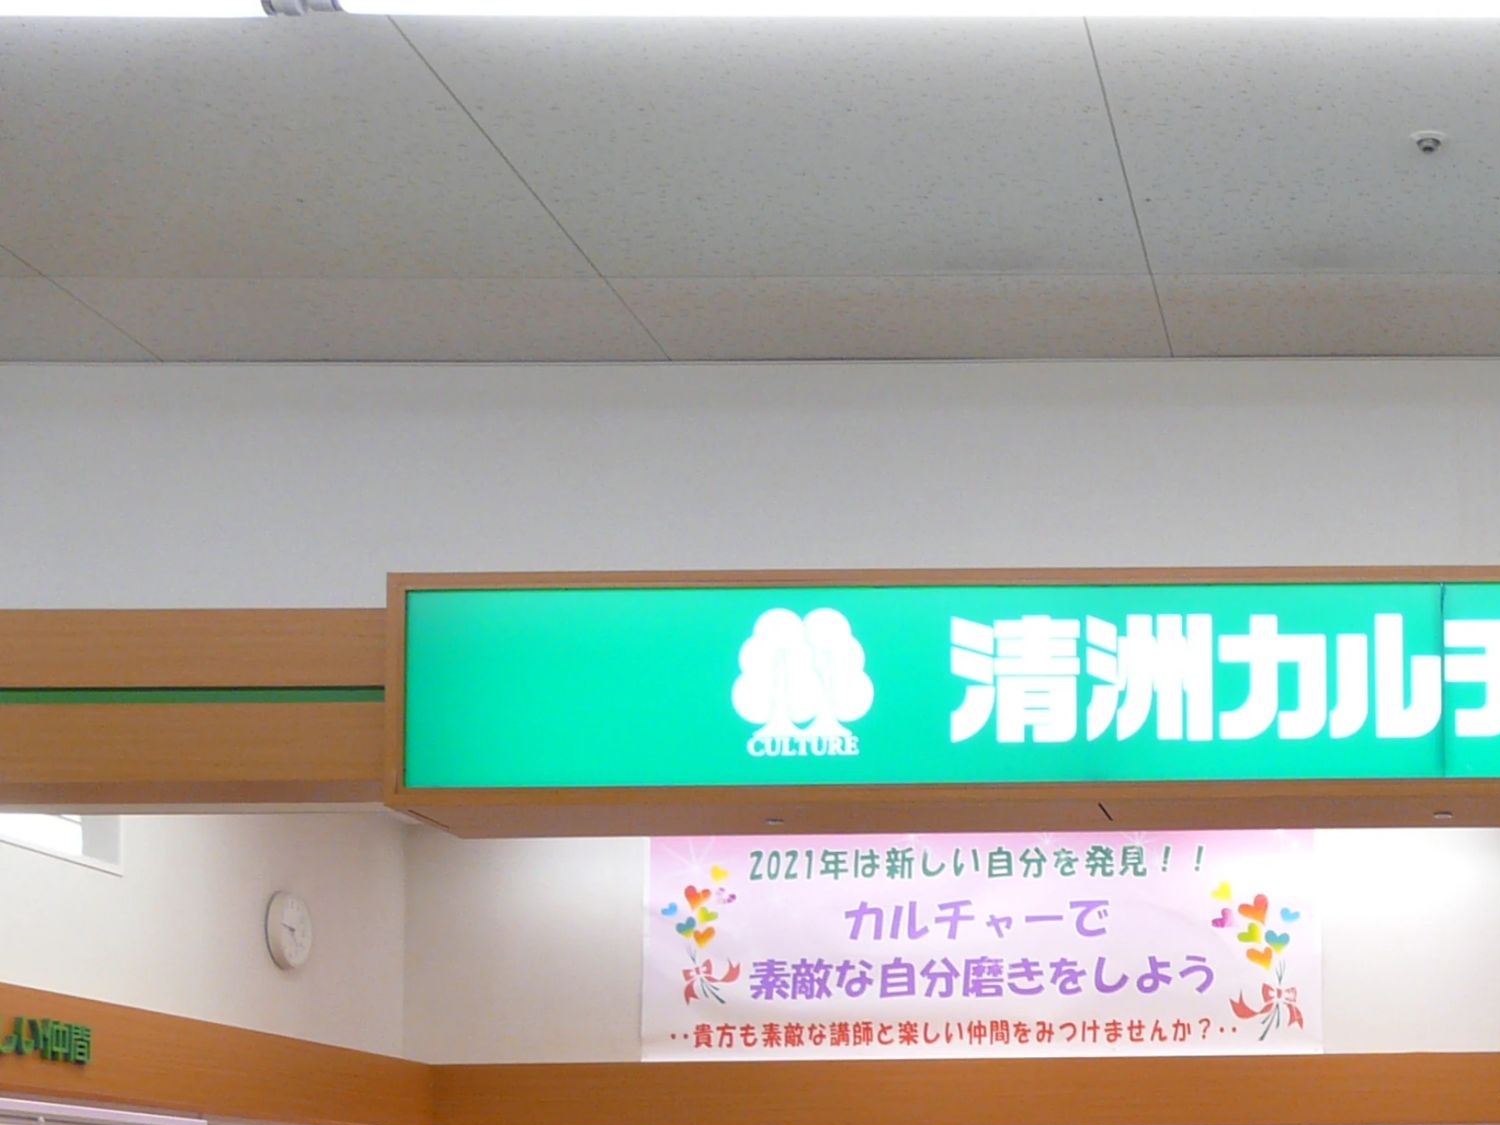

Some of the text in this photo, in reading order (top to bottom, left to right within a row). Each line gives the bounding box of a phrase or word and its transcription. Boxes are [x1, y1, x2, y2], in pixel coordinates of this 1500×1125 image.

[746, 735, 860, 757] CULTURE
[749, 845, 1205, 881] 2021年は新しい自分を発見！！
[844, 899, 1110, 941] カルチャーで
[749, 955, 1215, 1001] 素敵な自分磨きをしよう
